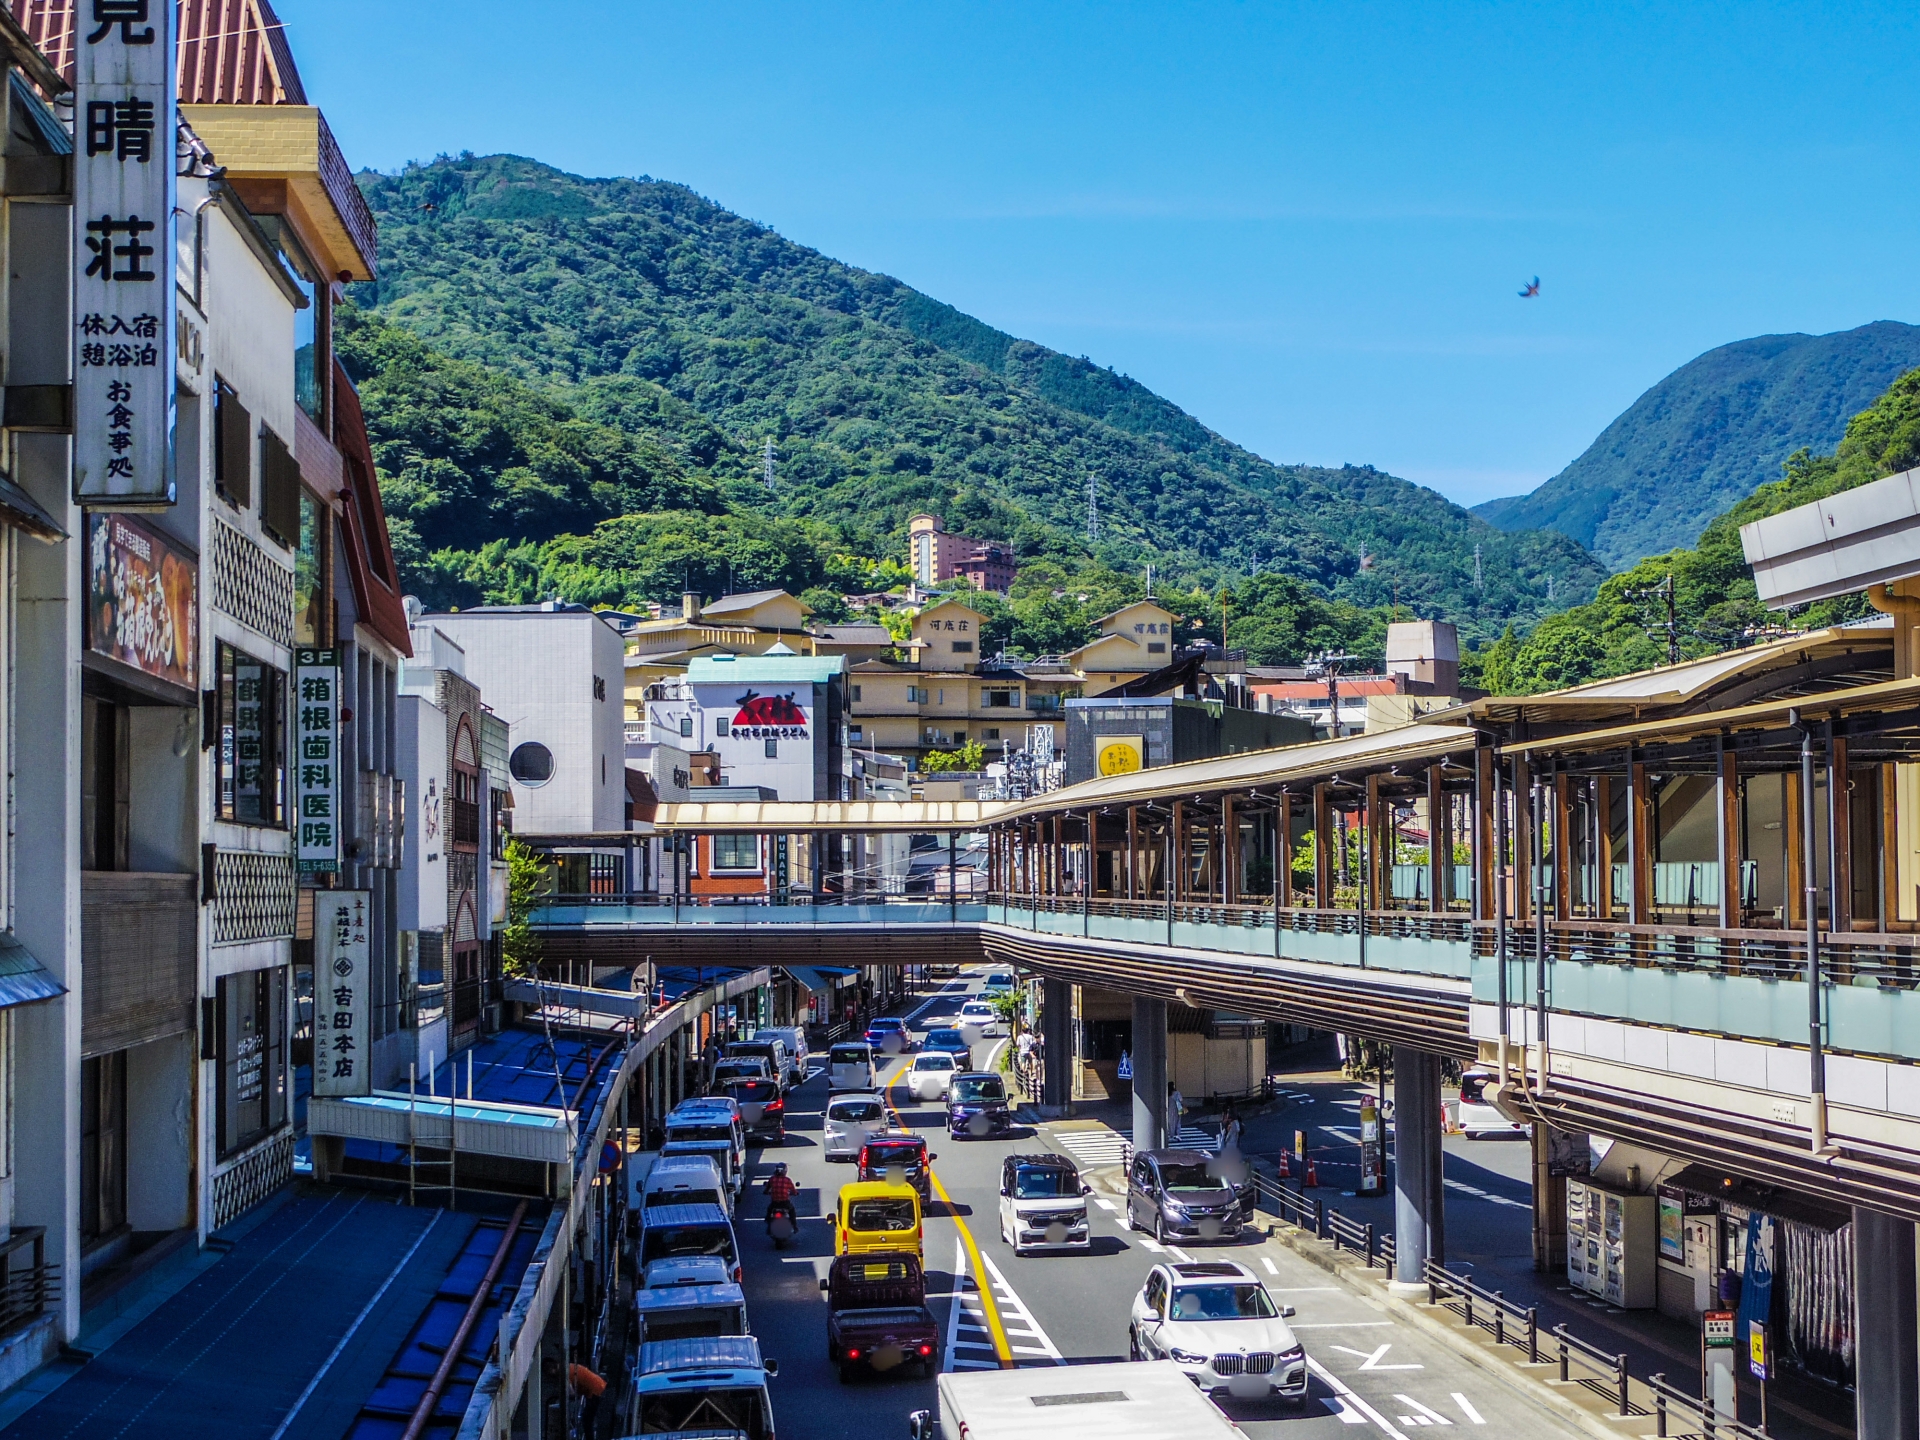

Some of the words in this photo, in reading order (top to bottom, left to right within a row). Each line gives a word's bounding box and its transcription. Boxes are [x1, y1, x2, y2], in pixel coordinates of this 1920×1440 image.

[86, 0, 156, 281] 見晴荘
[81, 313, 106, 366] 休憩
[107, 315, 133, 366] 入浴
[133, 313, 157, 366] 宿泊
[106, 379, 133, 478] お食事処
[301, 651, 332, 664] 3F
[301, 676, 332, 848] 箱根歯科医院
[300, 861, 312, 871] TEL
[313, 860, 336, 871] 5-6355
[353, 899, 366, 944] 土産処
[332, 985, 356, 1078] 吉田本店
